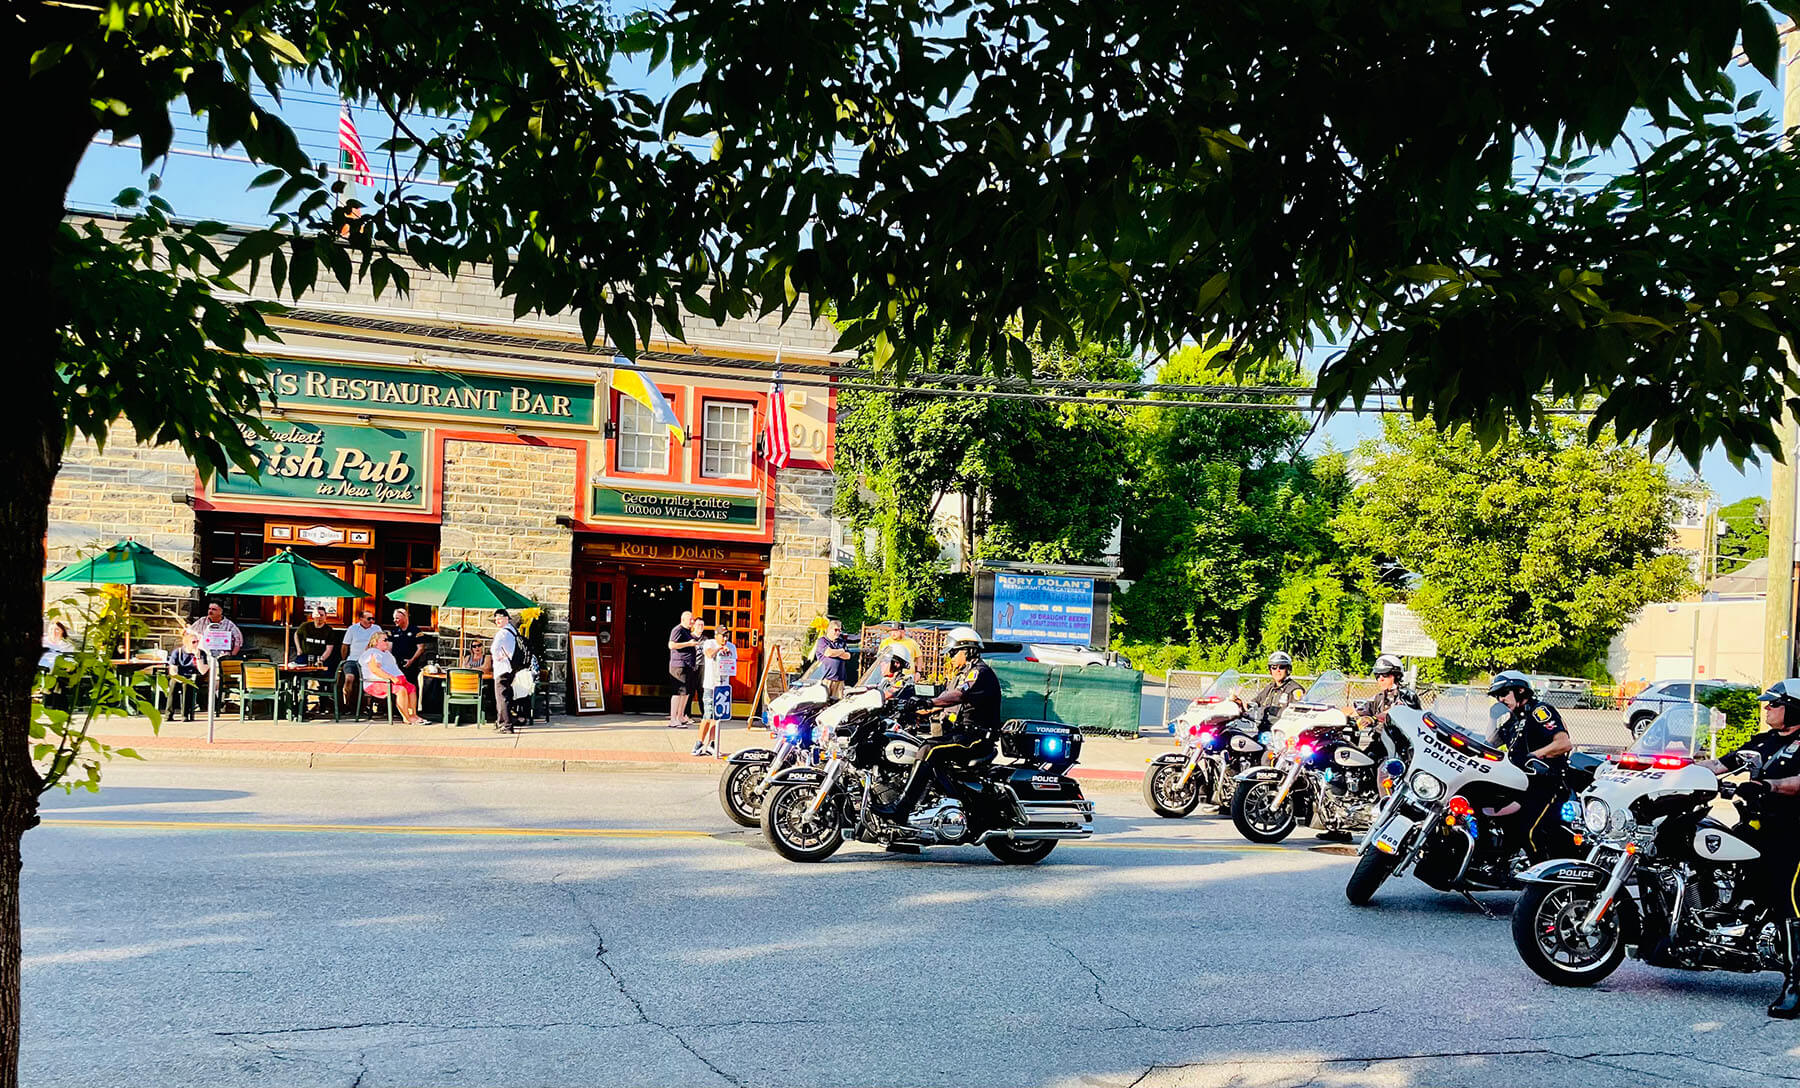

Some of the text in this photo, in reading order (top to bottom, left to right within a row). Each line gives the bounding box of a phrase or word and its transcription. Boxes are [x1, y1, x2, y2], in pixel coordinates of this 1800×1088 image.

[304, 370, 503, 411] RESTAURANT
[510, 386, 572, 417] BAR
[327, 447, 411, 484] Pub
[317, 482, 335, 495] in
[335, 480, 371, 498] New
[664, 506, 729, 520] WELCOMES
[998, 575, 1092, 589] RORY DOLAN'S
[1417, 726, 1492, 774] YONKERS
[1424, 747, 1465, 773] POLICE
[1031, 775, 1059, 783] POLICE
[1558, 868, 1595, 878] POLICE
